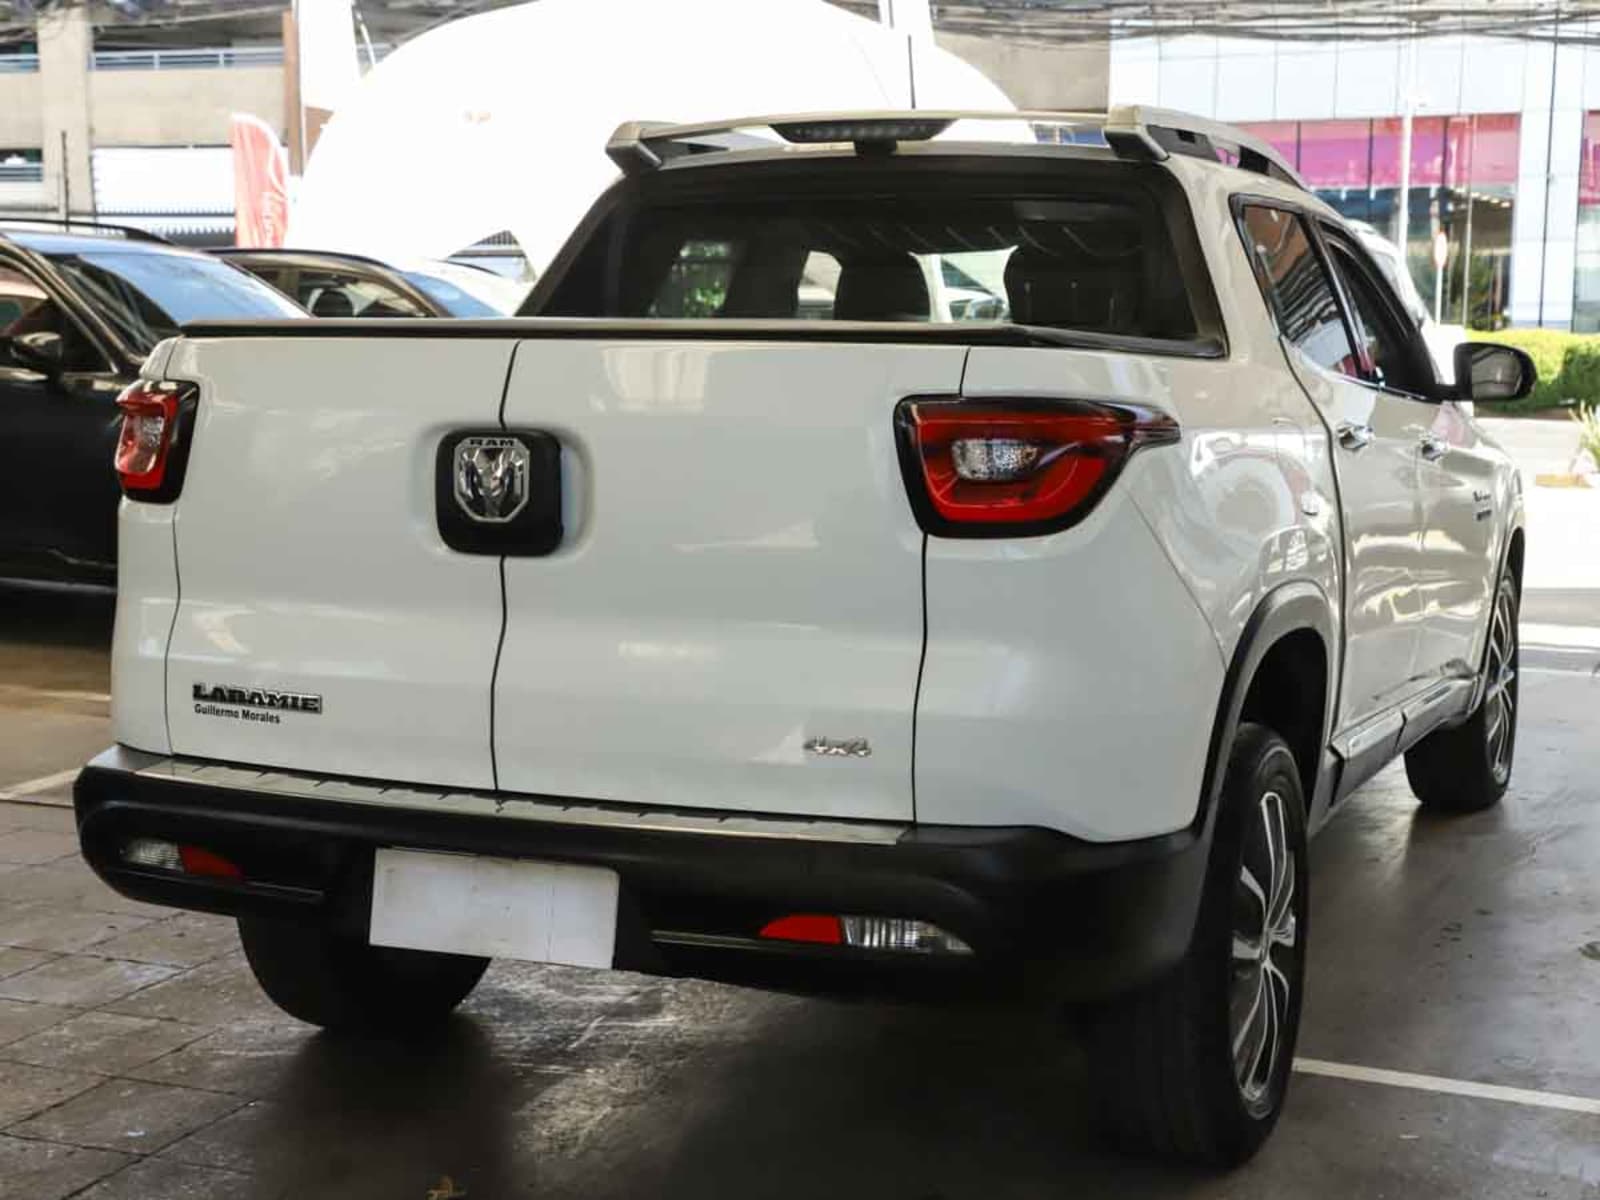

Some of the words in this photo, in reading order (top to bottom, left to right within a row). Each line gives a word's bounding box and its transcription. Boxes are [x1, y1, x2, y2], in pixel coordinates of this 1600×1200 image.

[469, 438, 515, 447] RAM
[193, 683, 322, 714] LARAMIE
[194, 703, 239, 719] Guillermo
[241, 709, 280, 723] Morales
